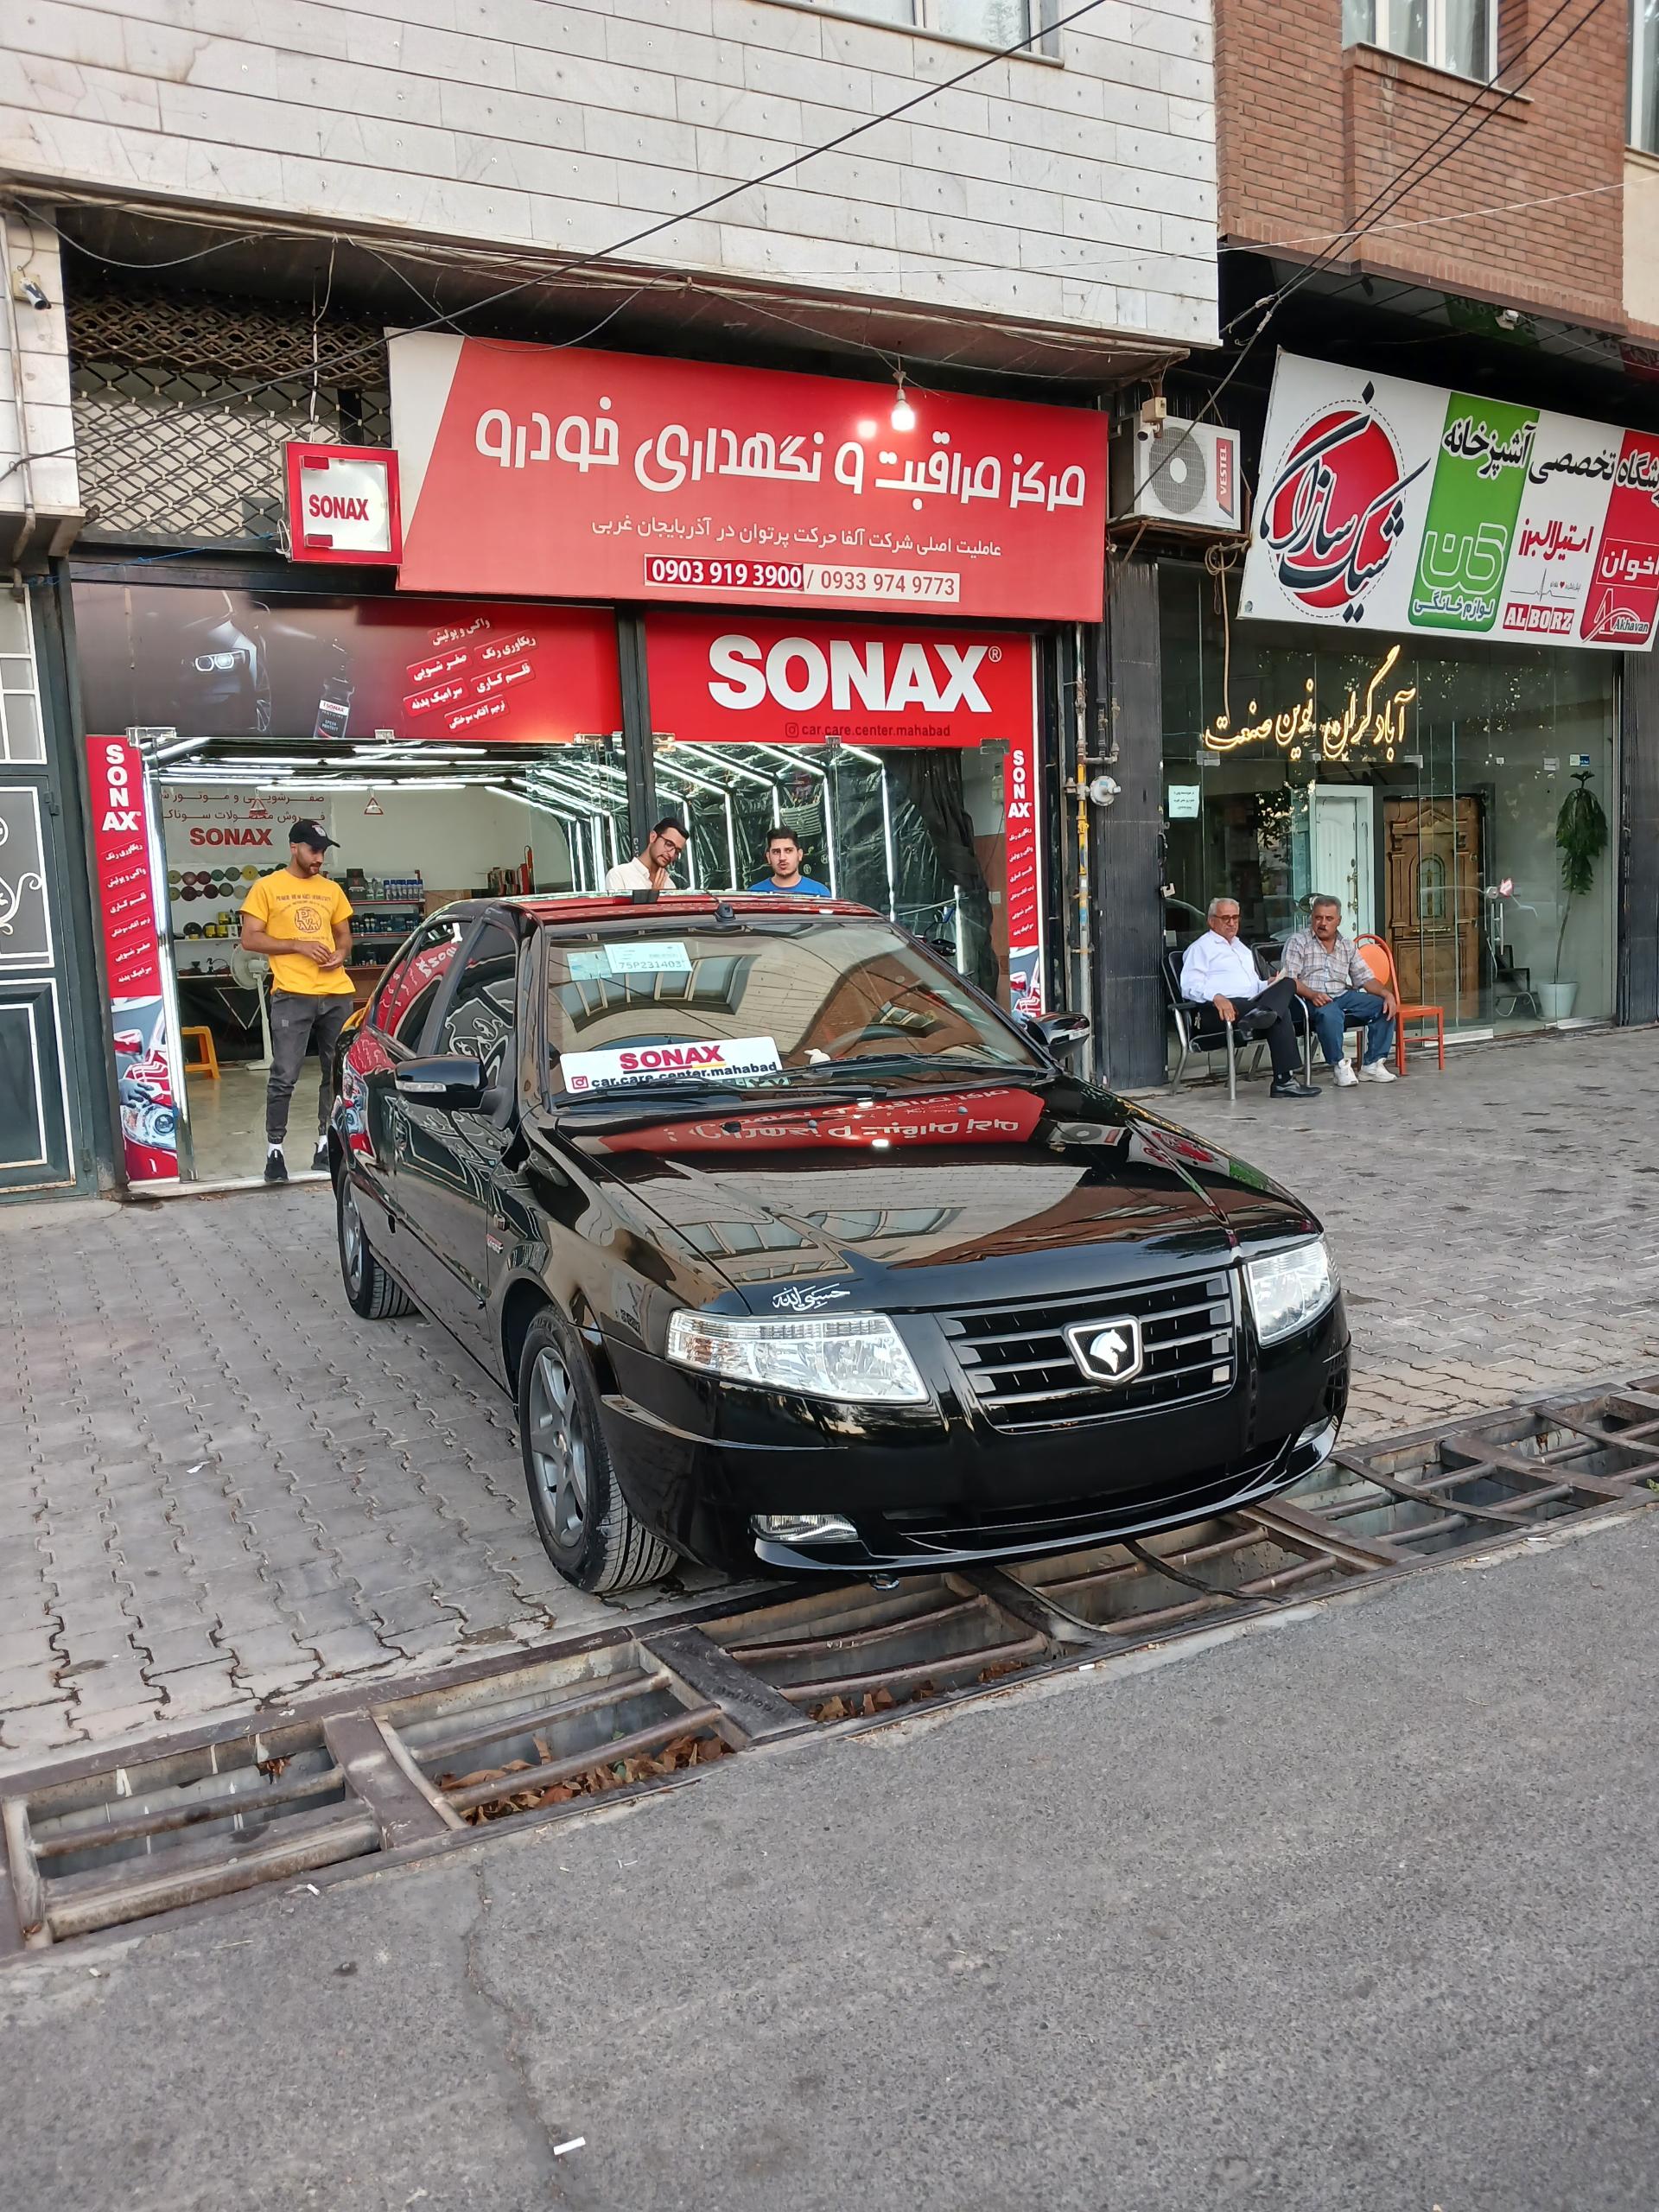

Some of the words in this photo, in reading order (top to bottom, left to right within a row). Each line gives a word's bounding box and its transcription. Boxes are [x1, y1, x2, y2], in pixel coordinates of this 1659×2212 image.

[475, 396, 620, 473] خودرو
[634, 423, 824, 493] نگهداری
[1445, 418, 1536, 476] آشپزخانه
[834, 442, 864, 495] و
[875, 430, 1001, 511] مراقبت
[1219, 445, 1228, 496] VESTEL
[1529, 449, 1617, 484] تخصصی
[1009, 453, 1086, 512] مرکز
[309, 493, 369, 521] SONAX
[591, 514, 633, 536] غربی
[637, 516, 712, 540] آذربایجان
[715, 524, 735, 542] در
[740, 524, 790, 549] پرتوان
[840, 527, 866, 546] آلفا
[793, 526, 837, 549] حرکت
[868, 532, 913, 554] شرکت
[916, 536, 951, 556] اصلی
[956, 541, 1001, 559] عاملیت
[652, 558, 704, 583] 0903
[709, 563, 748, 585] 919
[752, 563, 802, 588] 3900
[820, 569, 867, 591] 0933
[873, 573, 906, 594] 974
[912, 575, 955, 596] 9773
[1613, 616, 1649, 633] Akhavan
[801, 724, 951, 736] car.care.center.mahabad
[189, 827, 273, 847] SONAX
[620, 1046, 726, 1070] SONAX
